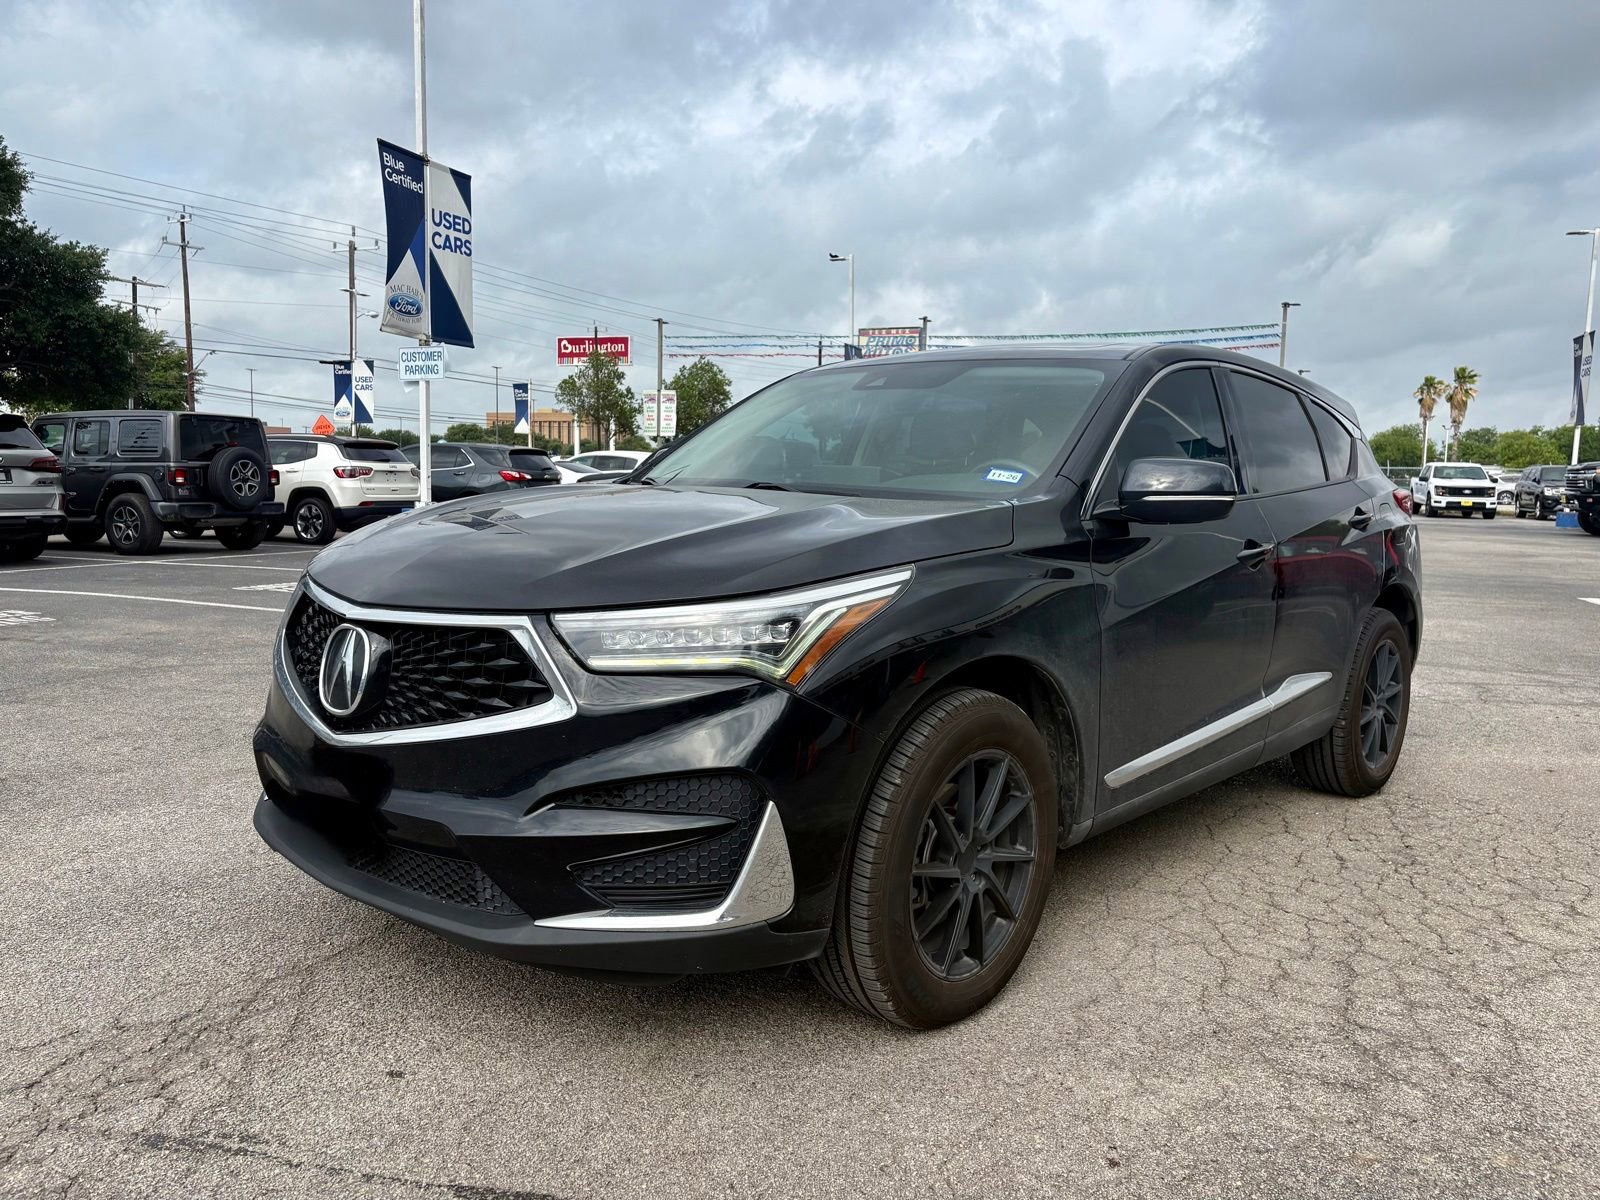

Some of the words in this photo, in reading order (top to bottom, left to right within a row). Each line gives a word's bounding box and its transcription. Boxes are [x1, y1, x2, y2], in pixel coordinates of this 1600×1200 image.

[383, 151, 405, 172] Blue
[384, 168, 424, 194] Certified
[431, 207, 472, 235] USED
[431, 231, 473, 257] CARS
[395, 295, 419, 315] Ford
[401, 350, 443, 363] CUSTOMER
[404, 364, 439, 376] PARKING
